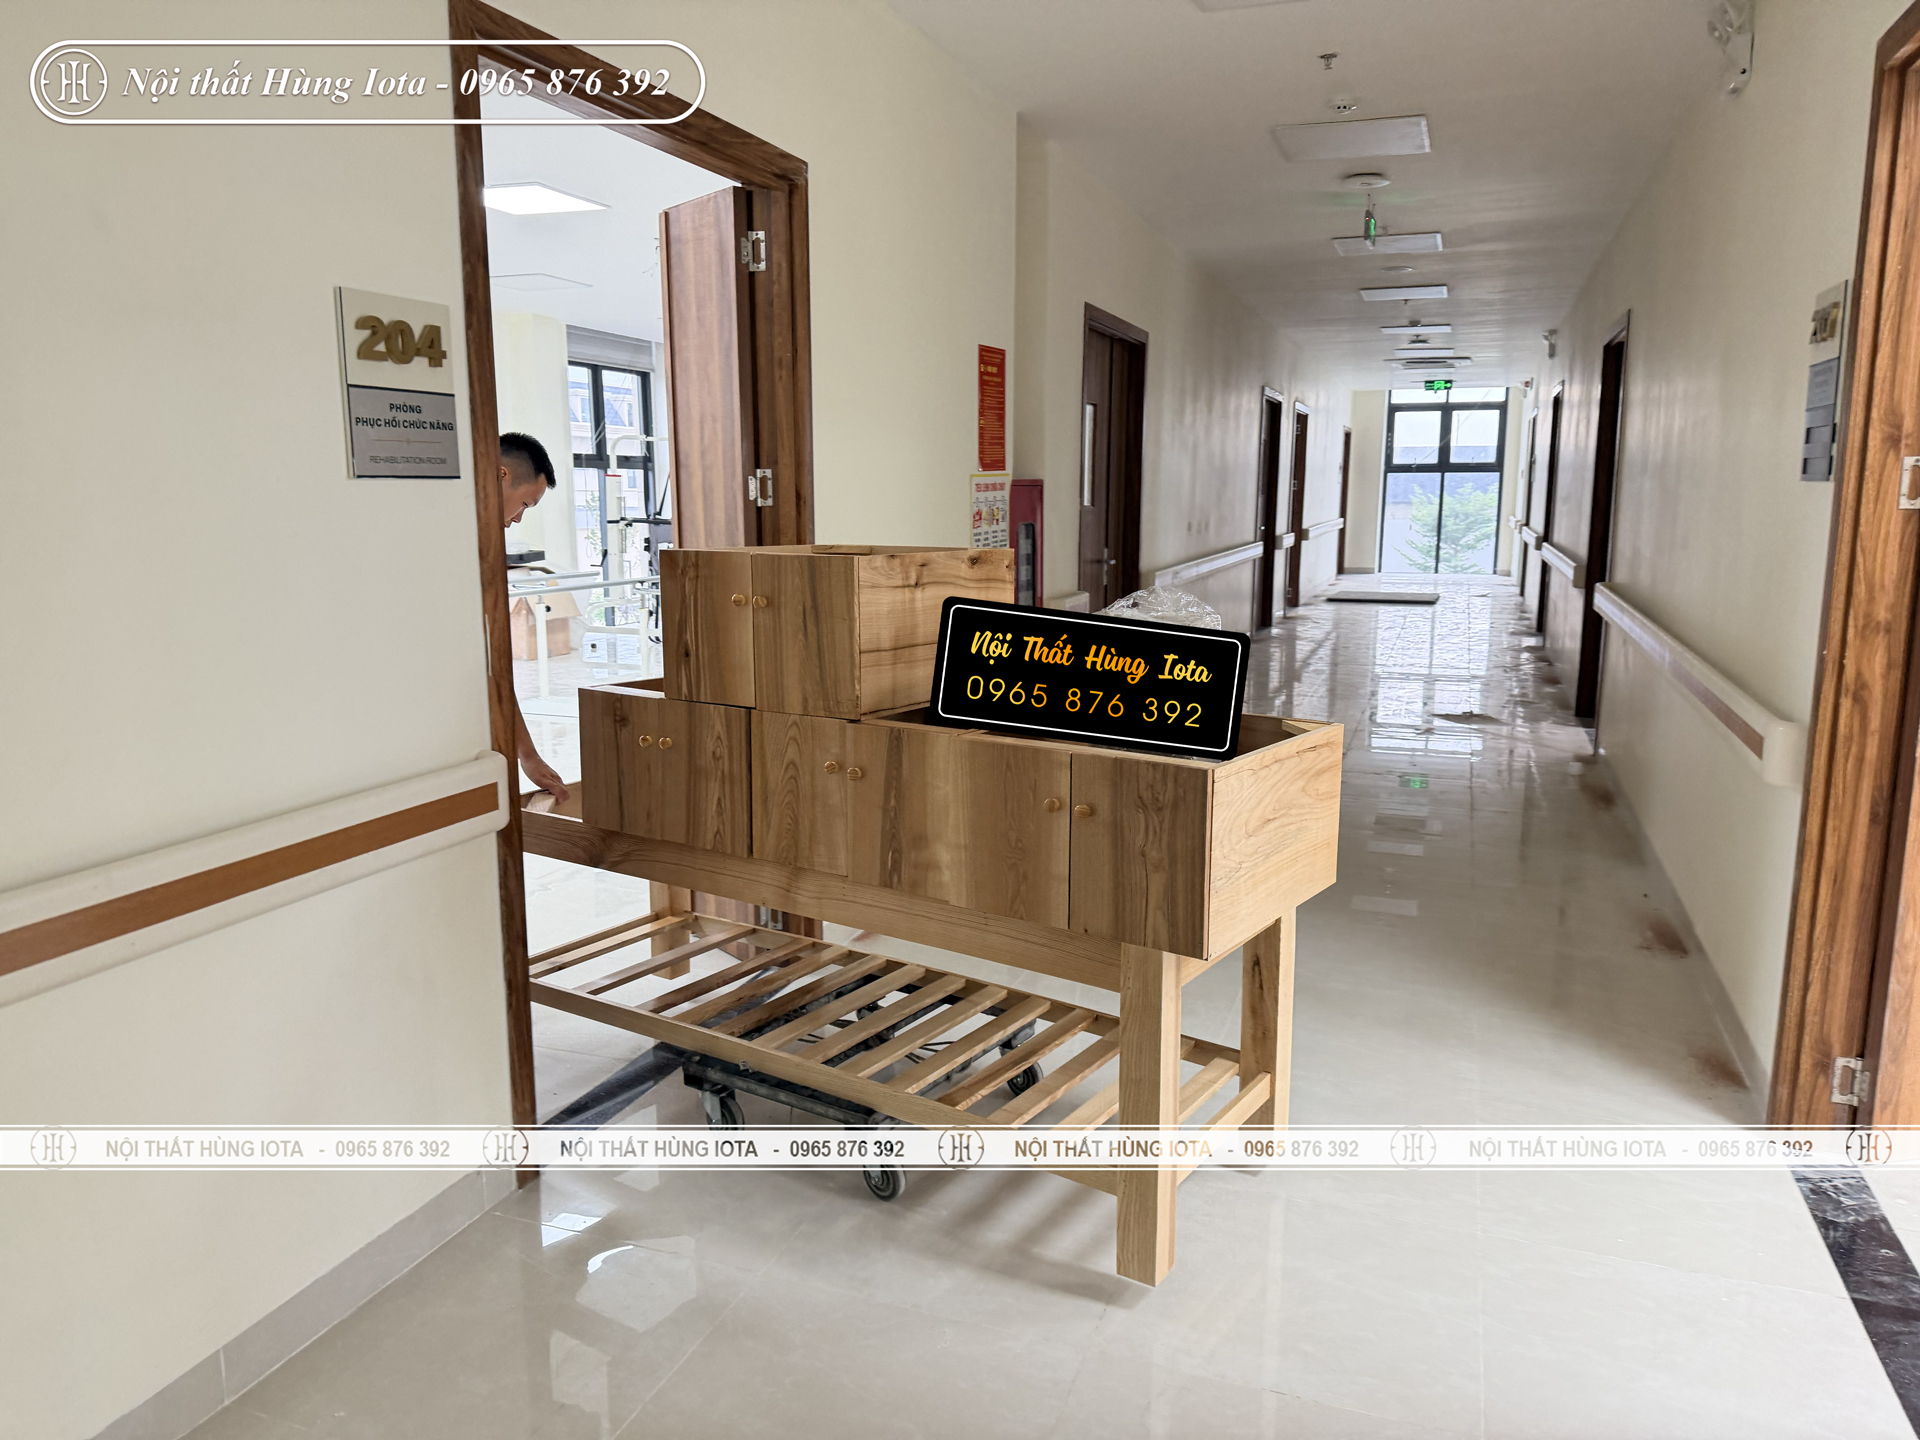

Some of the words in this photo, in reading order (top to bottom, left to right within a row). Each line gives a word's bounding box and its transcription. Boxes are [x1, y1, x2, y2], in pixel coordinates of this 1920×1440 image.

[355, 315, 447, 368] 204
[389, 402, 422, 414] PHÒNG
[355, 417, 382, 428] PHỤC
[369, 455, 425, 464] REHABILITATION
[426, 457, 447, 465] ROOM
